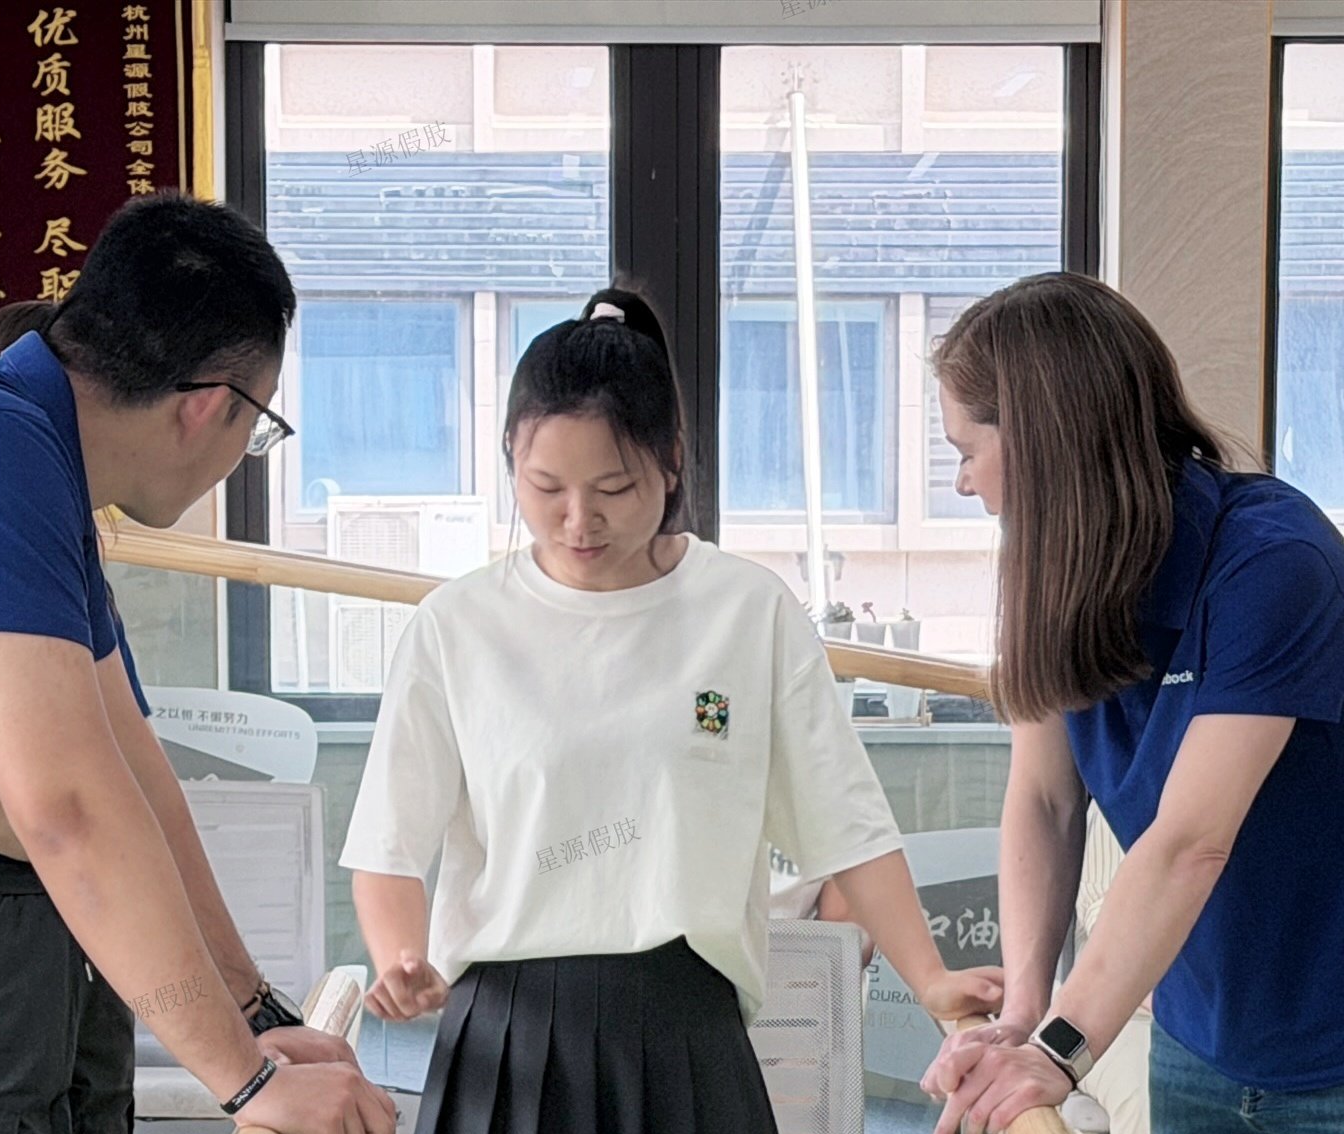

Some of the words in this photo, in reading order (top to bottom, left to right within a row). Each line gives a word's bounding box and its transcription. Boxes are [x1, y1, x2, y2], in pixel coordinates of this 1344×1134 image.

[27, 8, 87, 190] 优质服务
[120, 5, 155, 195] 杭州星源假肢公司全体
